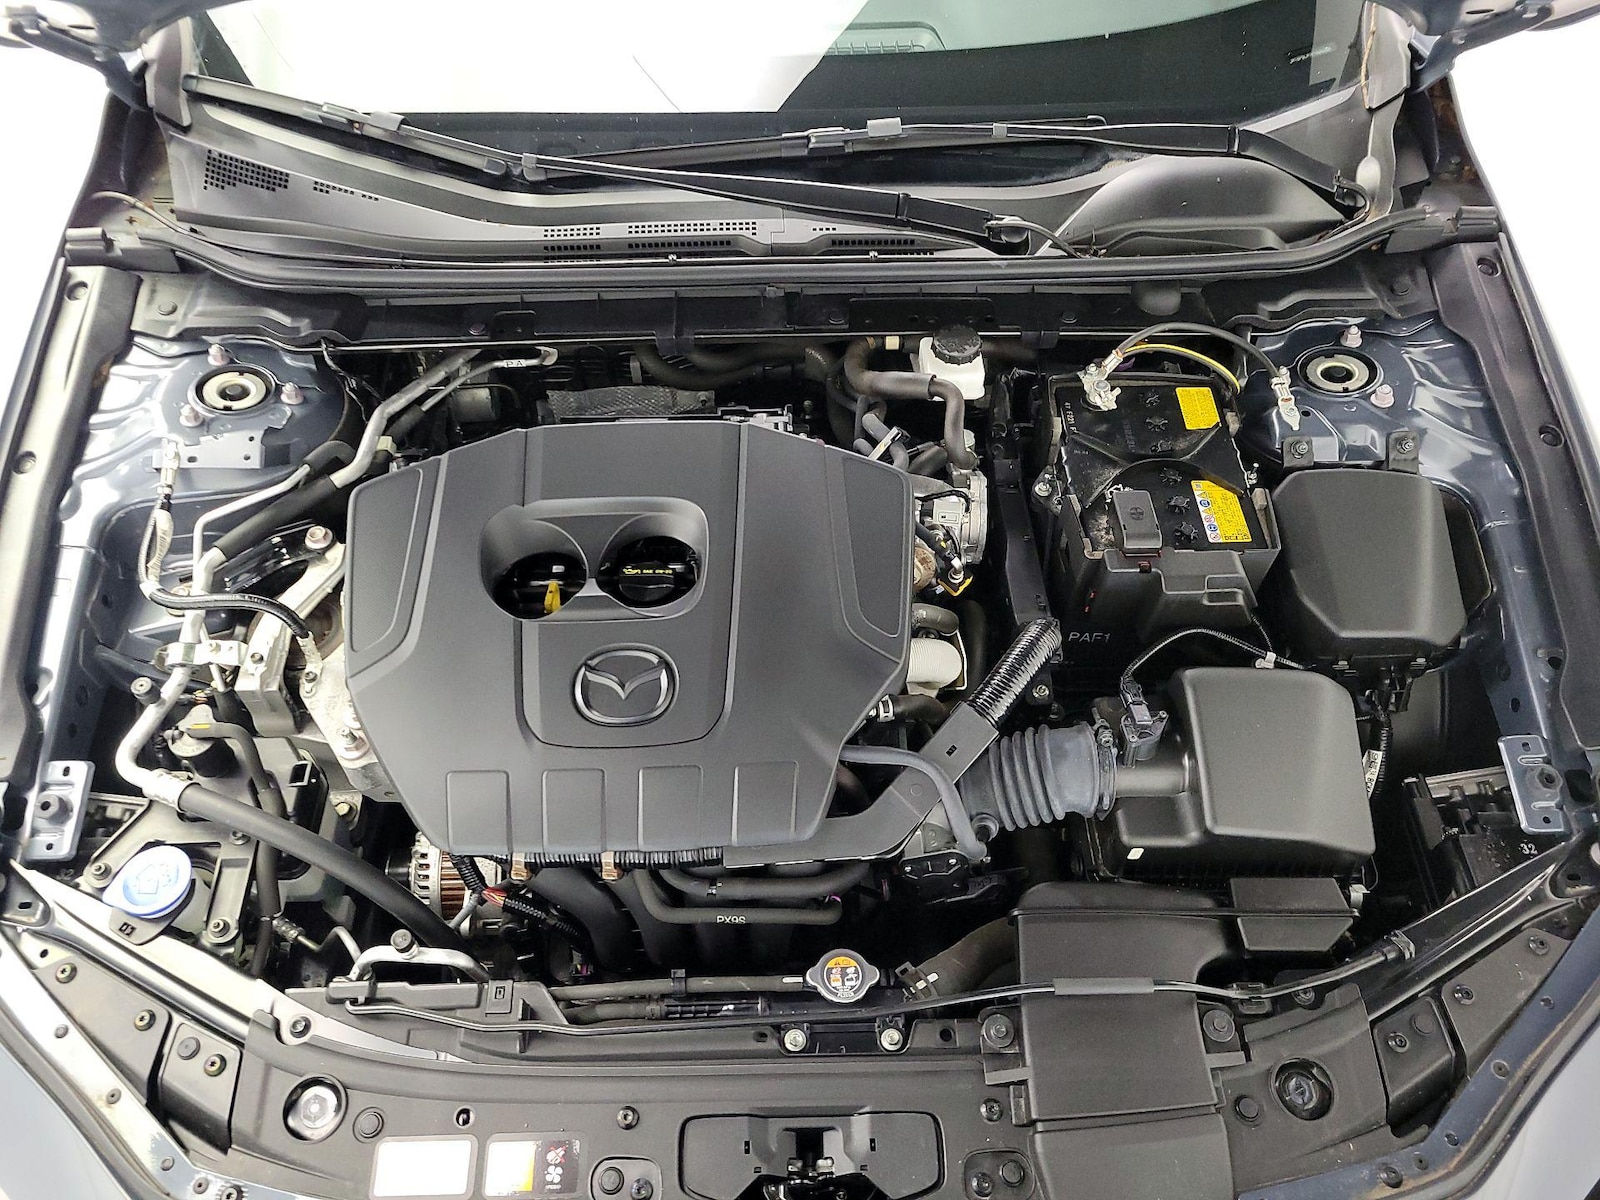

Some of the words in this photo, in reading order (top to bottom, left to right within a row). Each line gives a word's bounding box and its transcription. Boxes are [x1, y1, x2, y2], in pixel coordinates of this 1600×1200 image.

[1068, 632, 1111, 642] PAF1
[1519, 843, 1538, 855] 32
[716, 915, 746, 925] PX9S
